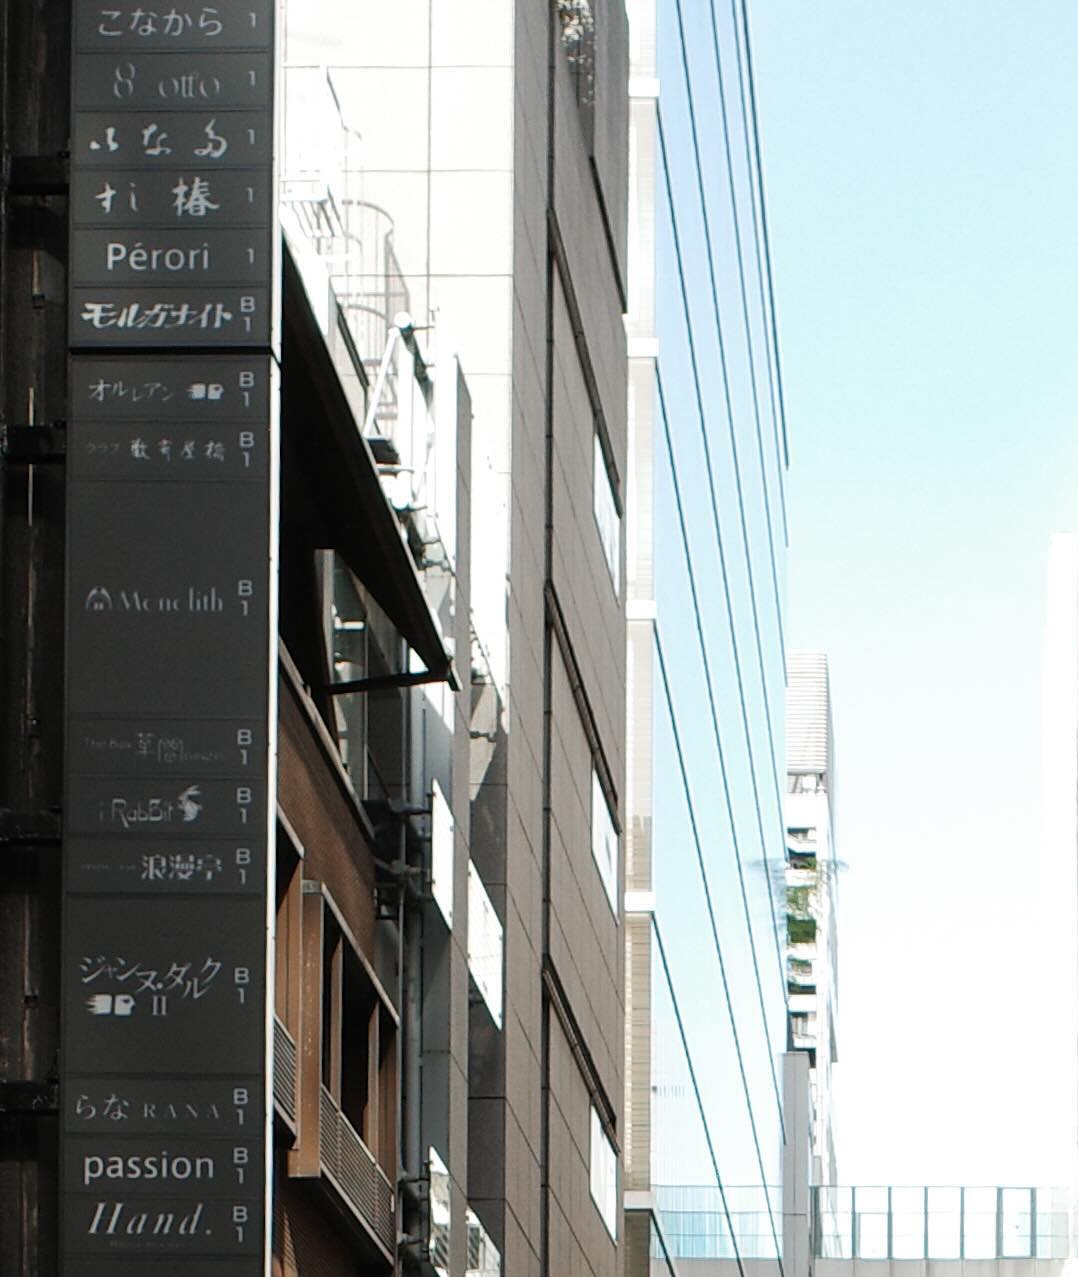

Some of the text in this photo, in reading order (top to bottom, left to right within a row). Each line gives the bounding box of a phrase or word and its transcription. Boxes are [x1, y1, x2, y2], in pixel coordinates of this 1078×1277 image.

[99, 9, 222, 36] こなから
[107, 243, 209, 271] Pérori
[81, 303, 233, 329] モルガナイト
[89, 379, 174, 401] オルレアン
[75, 1094, 129, 1120] らな
[84, 1151, 214, 1184] passion
